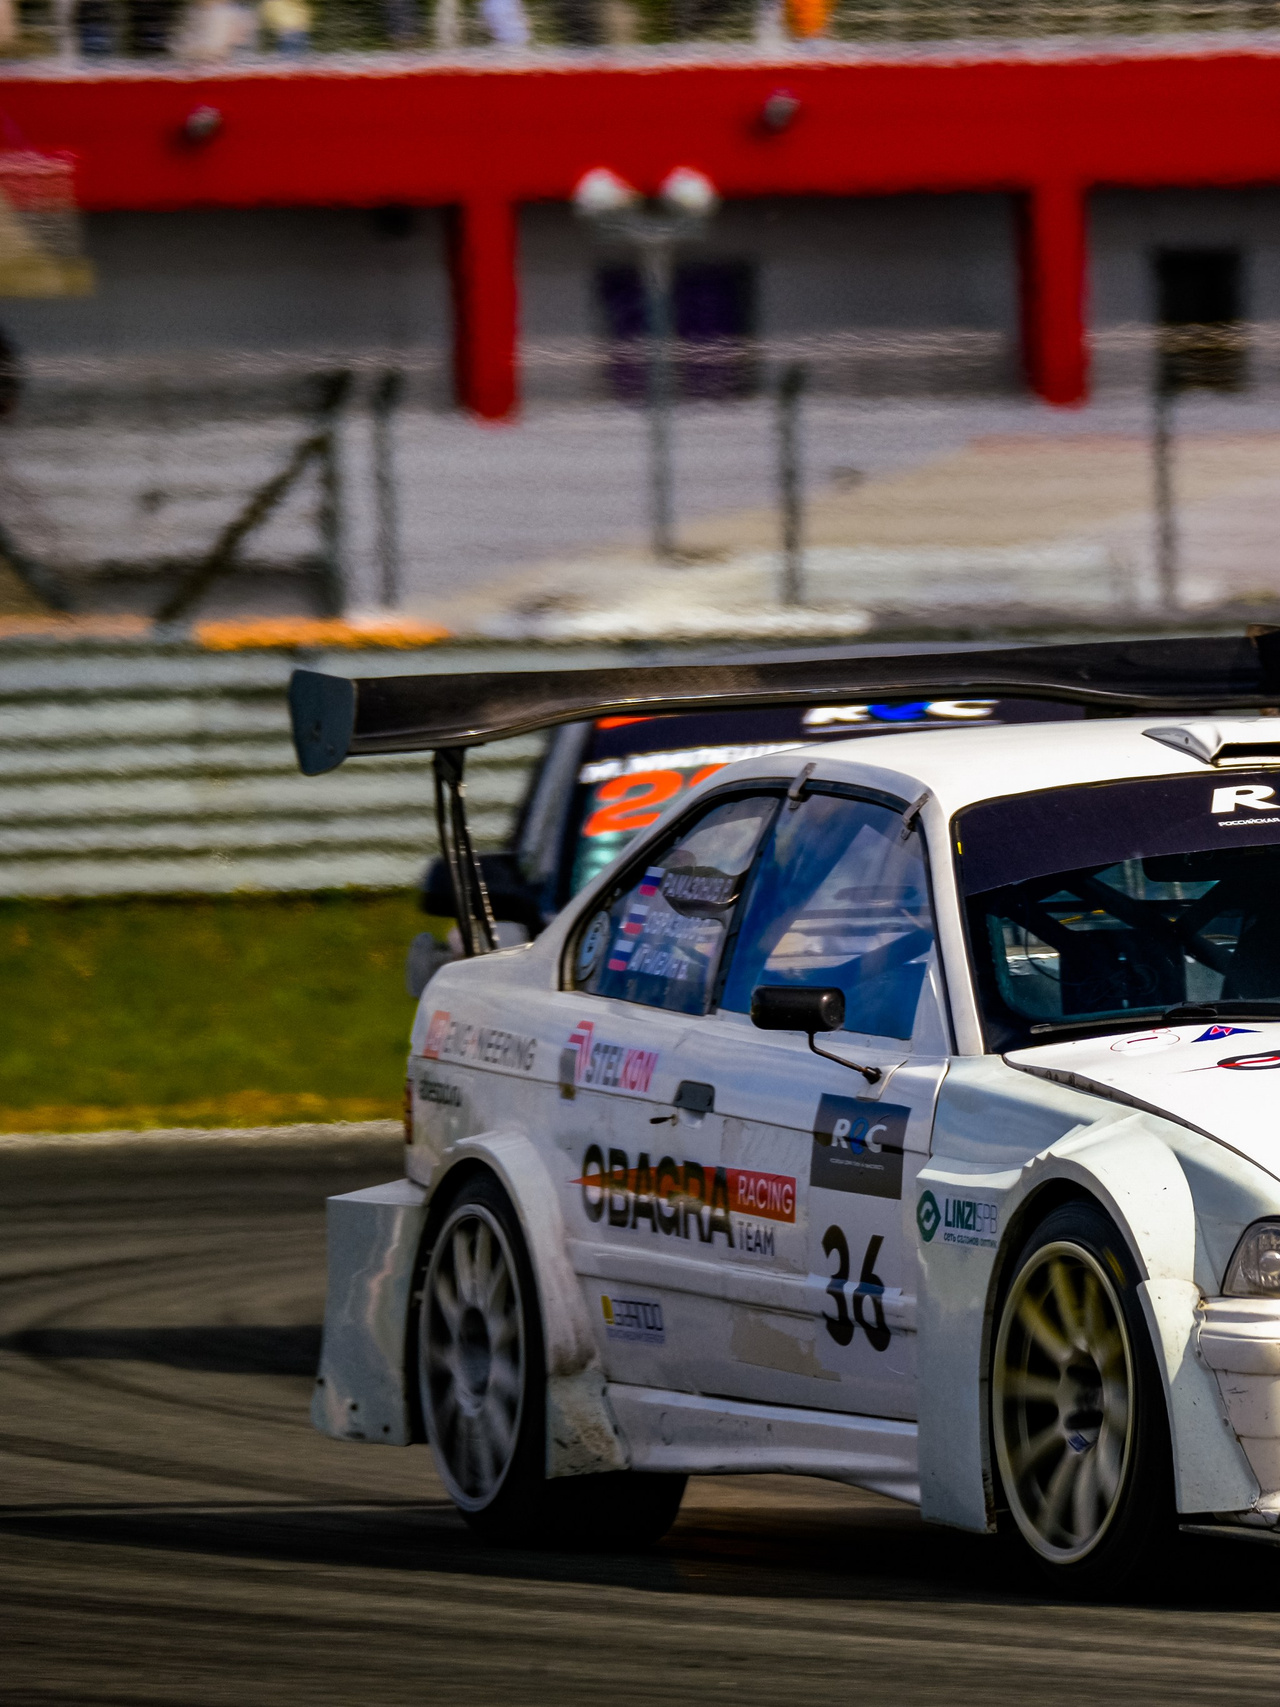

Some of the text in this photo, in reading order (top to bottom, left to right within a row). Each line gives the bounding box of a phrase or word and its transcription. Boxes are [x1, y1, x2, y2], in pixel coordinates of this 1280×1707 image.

[1218, 817, 1280, 827] РОССИЙСКАЯ
[585, 1042, 660, 1093] STELKON
[581, 1144, 735, 1248] OBAGRA
[738, 1176, 793, 1215] RACING
[738, 1221, 775, 1256] TEAM
[821, 1224, 892, 1353] 36
